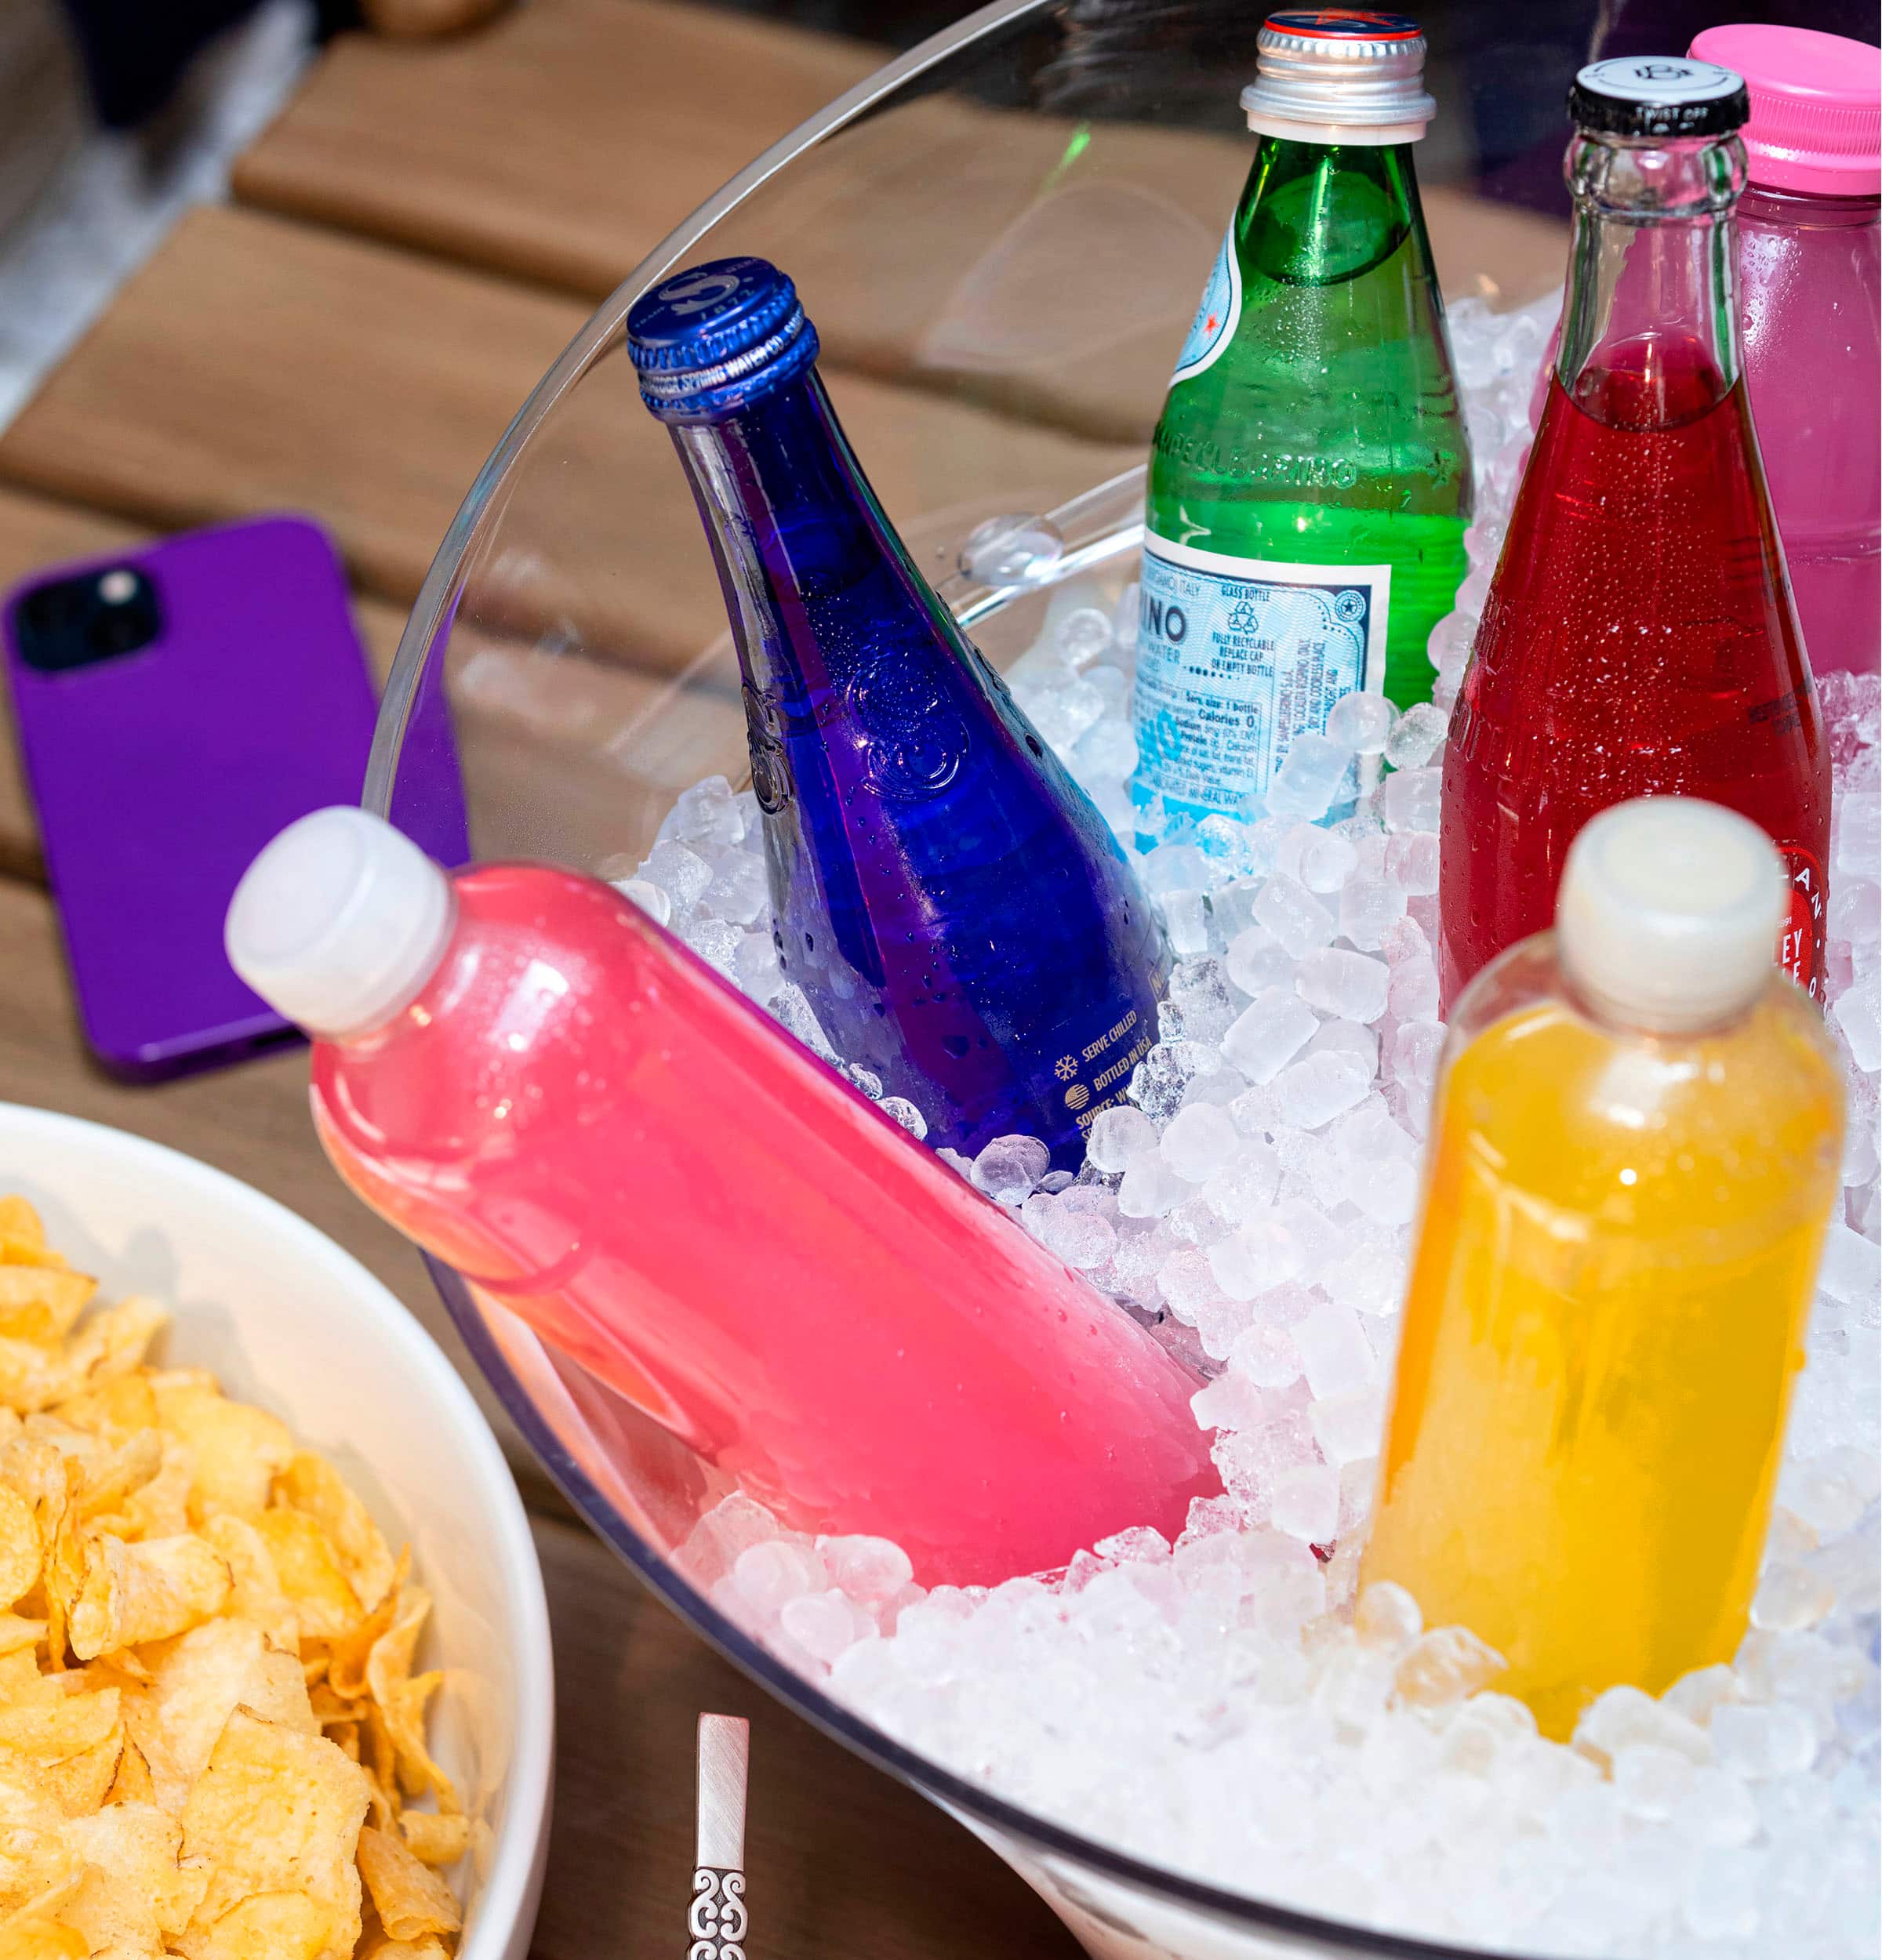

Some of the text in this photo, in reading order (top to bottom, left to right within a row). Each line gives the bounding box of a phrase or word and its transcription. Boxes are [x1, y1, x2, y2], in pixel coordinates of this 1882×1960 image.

[1635, 106, 1709, 122] TWIST OFF
[681, 365, 727, 392] SPRING
[725, 347, 768, 379] WATER
[1221, 585, 1270, 602] GLASS BOTTLE
[1212, 631, 1275, 651] FULLY RECYCLABLE
[1150, 641, 1180, 665] WATER
[1219, 645, 1264, 662] REPLACE CAP
[1222, 661, 1245, 674] EMPTY
[1247, 663, 1274, 677] BOTTLE
[1205, 698, 1223, 710] size:
[1233, 702, 1259, 714] bottle
[1198, 708, 1239, 726] Calories
[1081, 1010, 1138, 1062] SERVE CHILLED
[1092, 1035, 1154, 1092] BOTTLED IN USA
